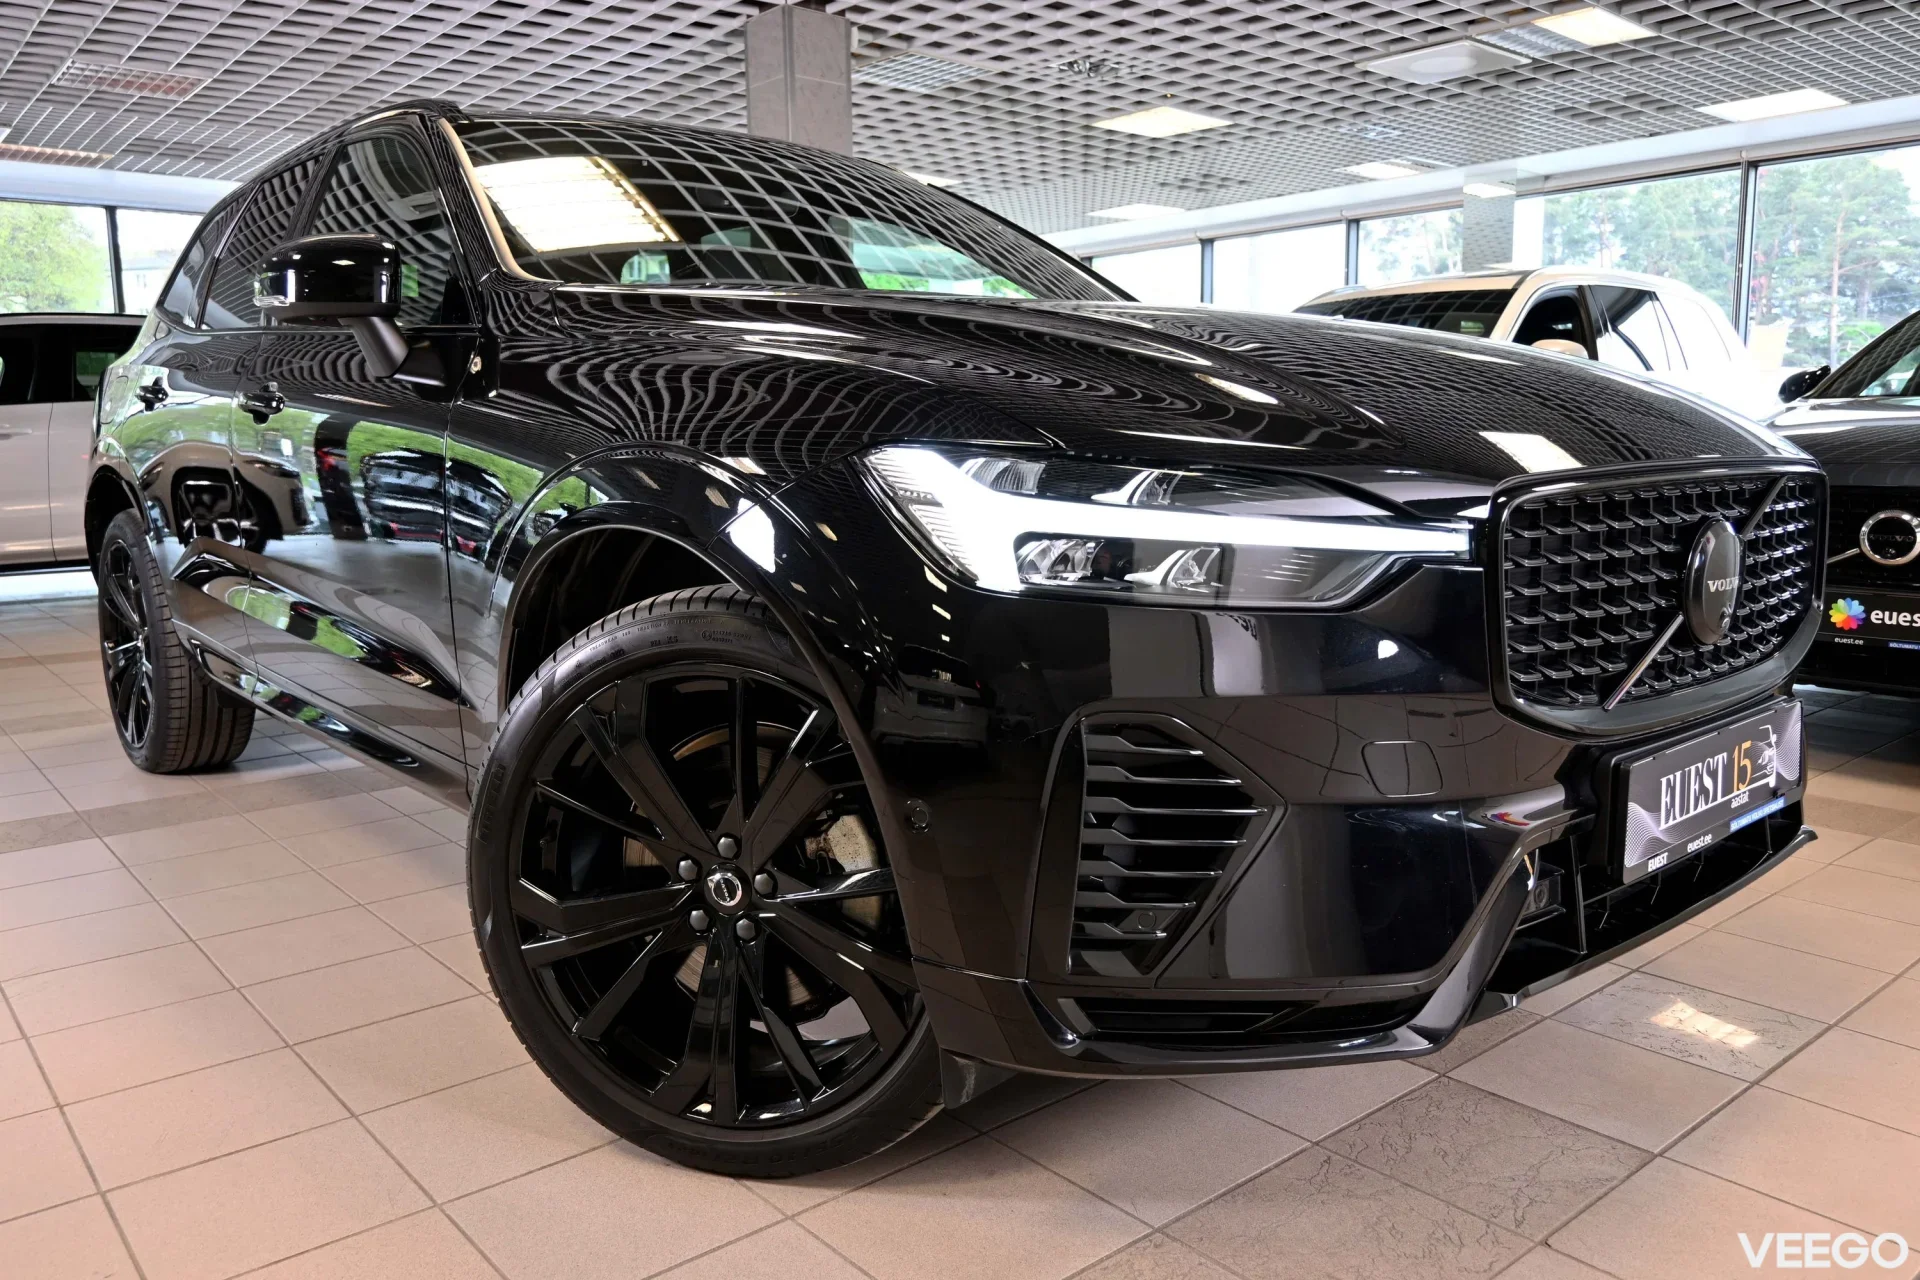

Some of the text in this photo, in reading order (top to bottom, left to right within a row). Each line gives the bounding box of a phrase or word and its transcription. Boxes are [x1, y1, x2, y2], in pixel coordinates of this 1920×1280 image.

[1707, 576, 1739, 593] VOLV
[1834, 637, 1864, 646] euest.ee
[1659, 752, 1727, 831] EUEST
[1732, 740, 1753, 793] 15
[1730, 791, 1749, 809] aastat
[1687, 833, 1712, 852] euest.ee
[1647, 852, 1669, 872] EUEST
